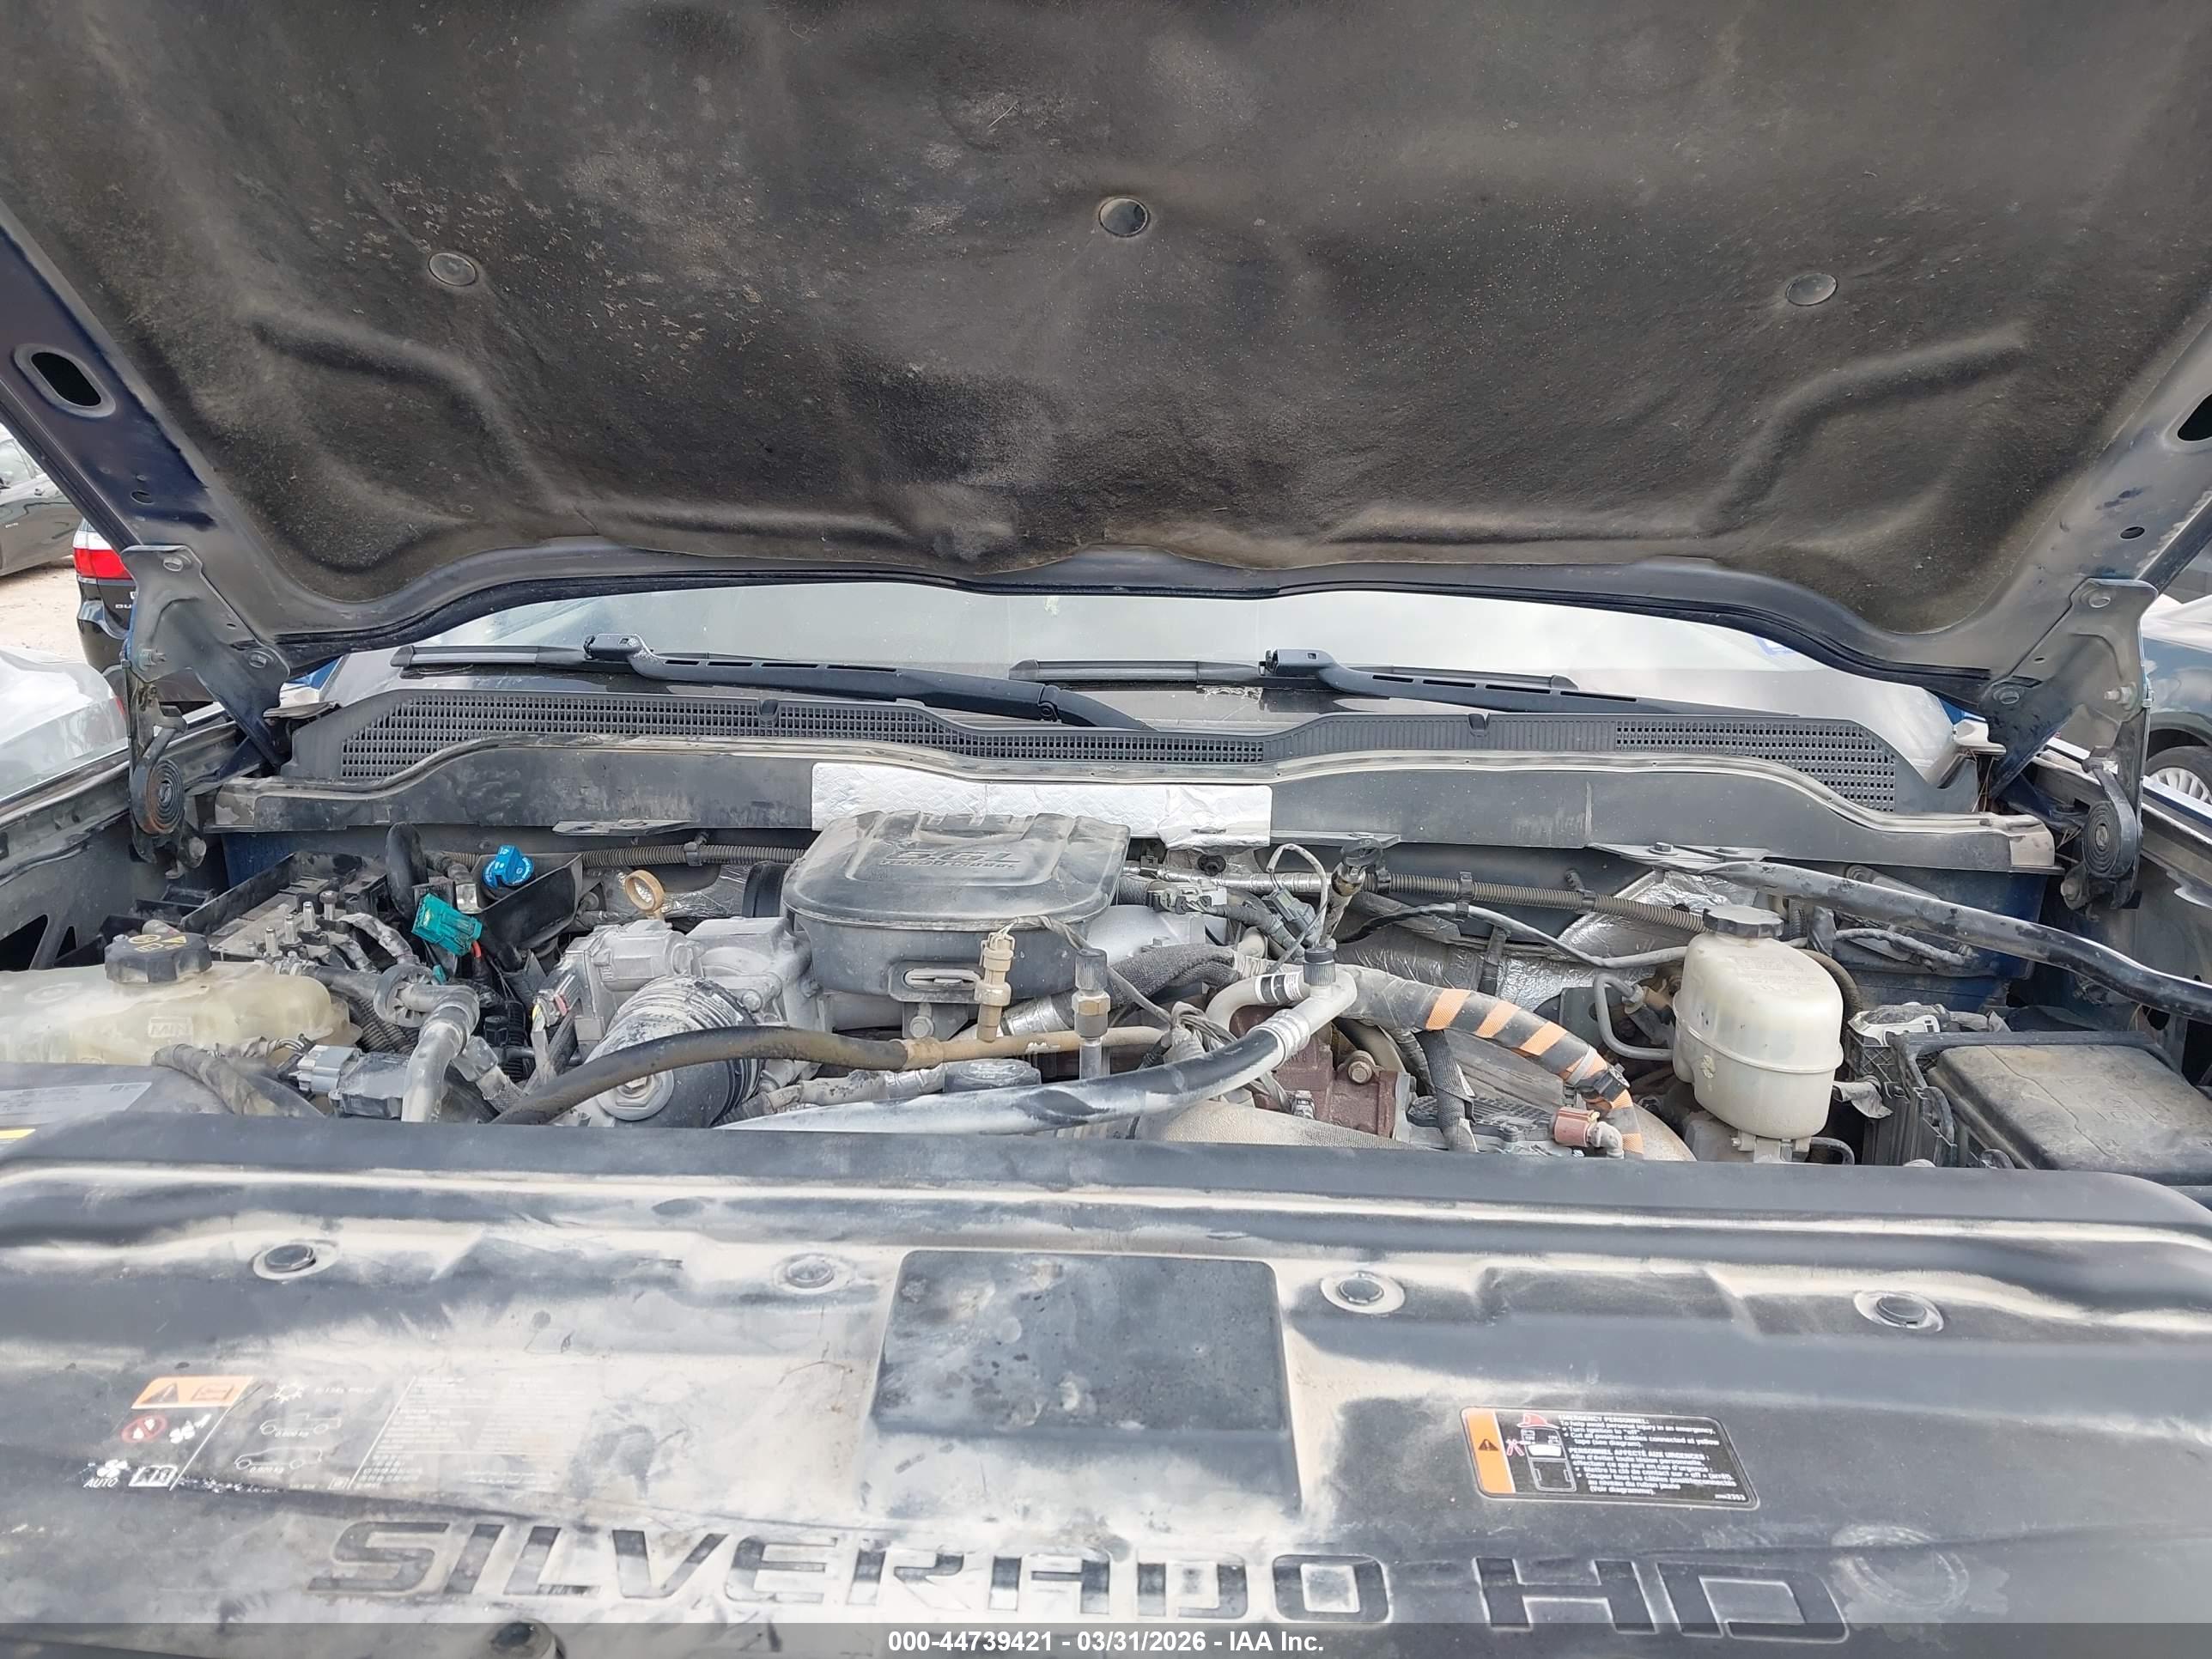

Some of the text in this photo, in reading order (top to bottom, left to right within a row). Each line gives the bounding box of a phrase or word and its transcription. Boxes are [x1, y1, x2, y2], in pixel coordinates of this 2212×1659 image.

[150, 1023, 190, 1036] MIN
[83, 1476, 118, 1488] AUTO
[307, 1521, 1850, 1644] SILVERADO HD
